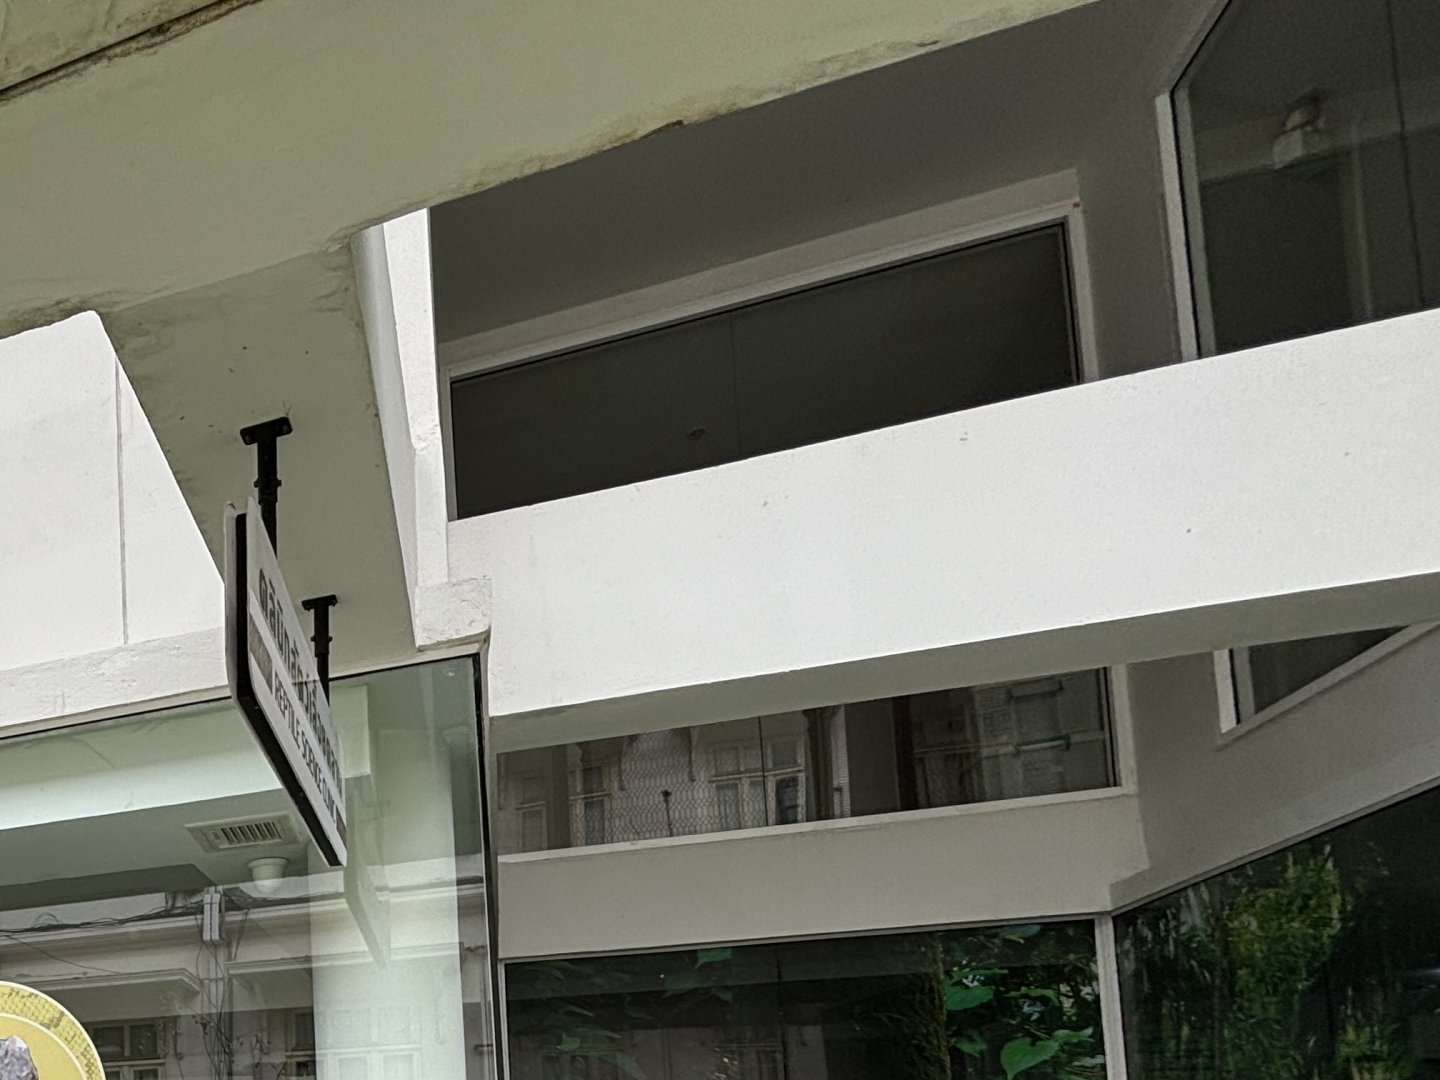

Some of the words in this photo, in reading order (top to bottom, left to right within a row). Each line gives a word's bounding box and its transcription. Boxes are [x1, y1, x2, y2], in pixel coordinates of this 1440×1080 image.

[274, 669, 301, 750] REPTILE
[301, 729, 322, 795] SCIENCE
[322, 777, 336, 824] CLINIC
